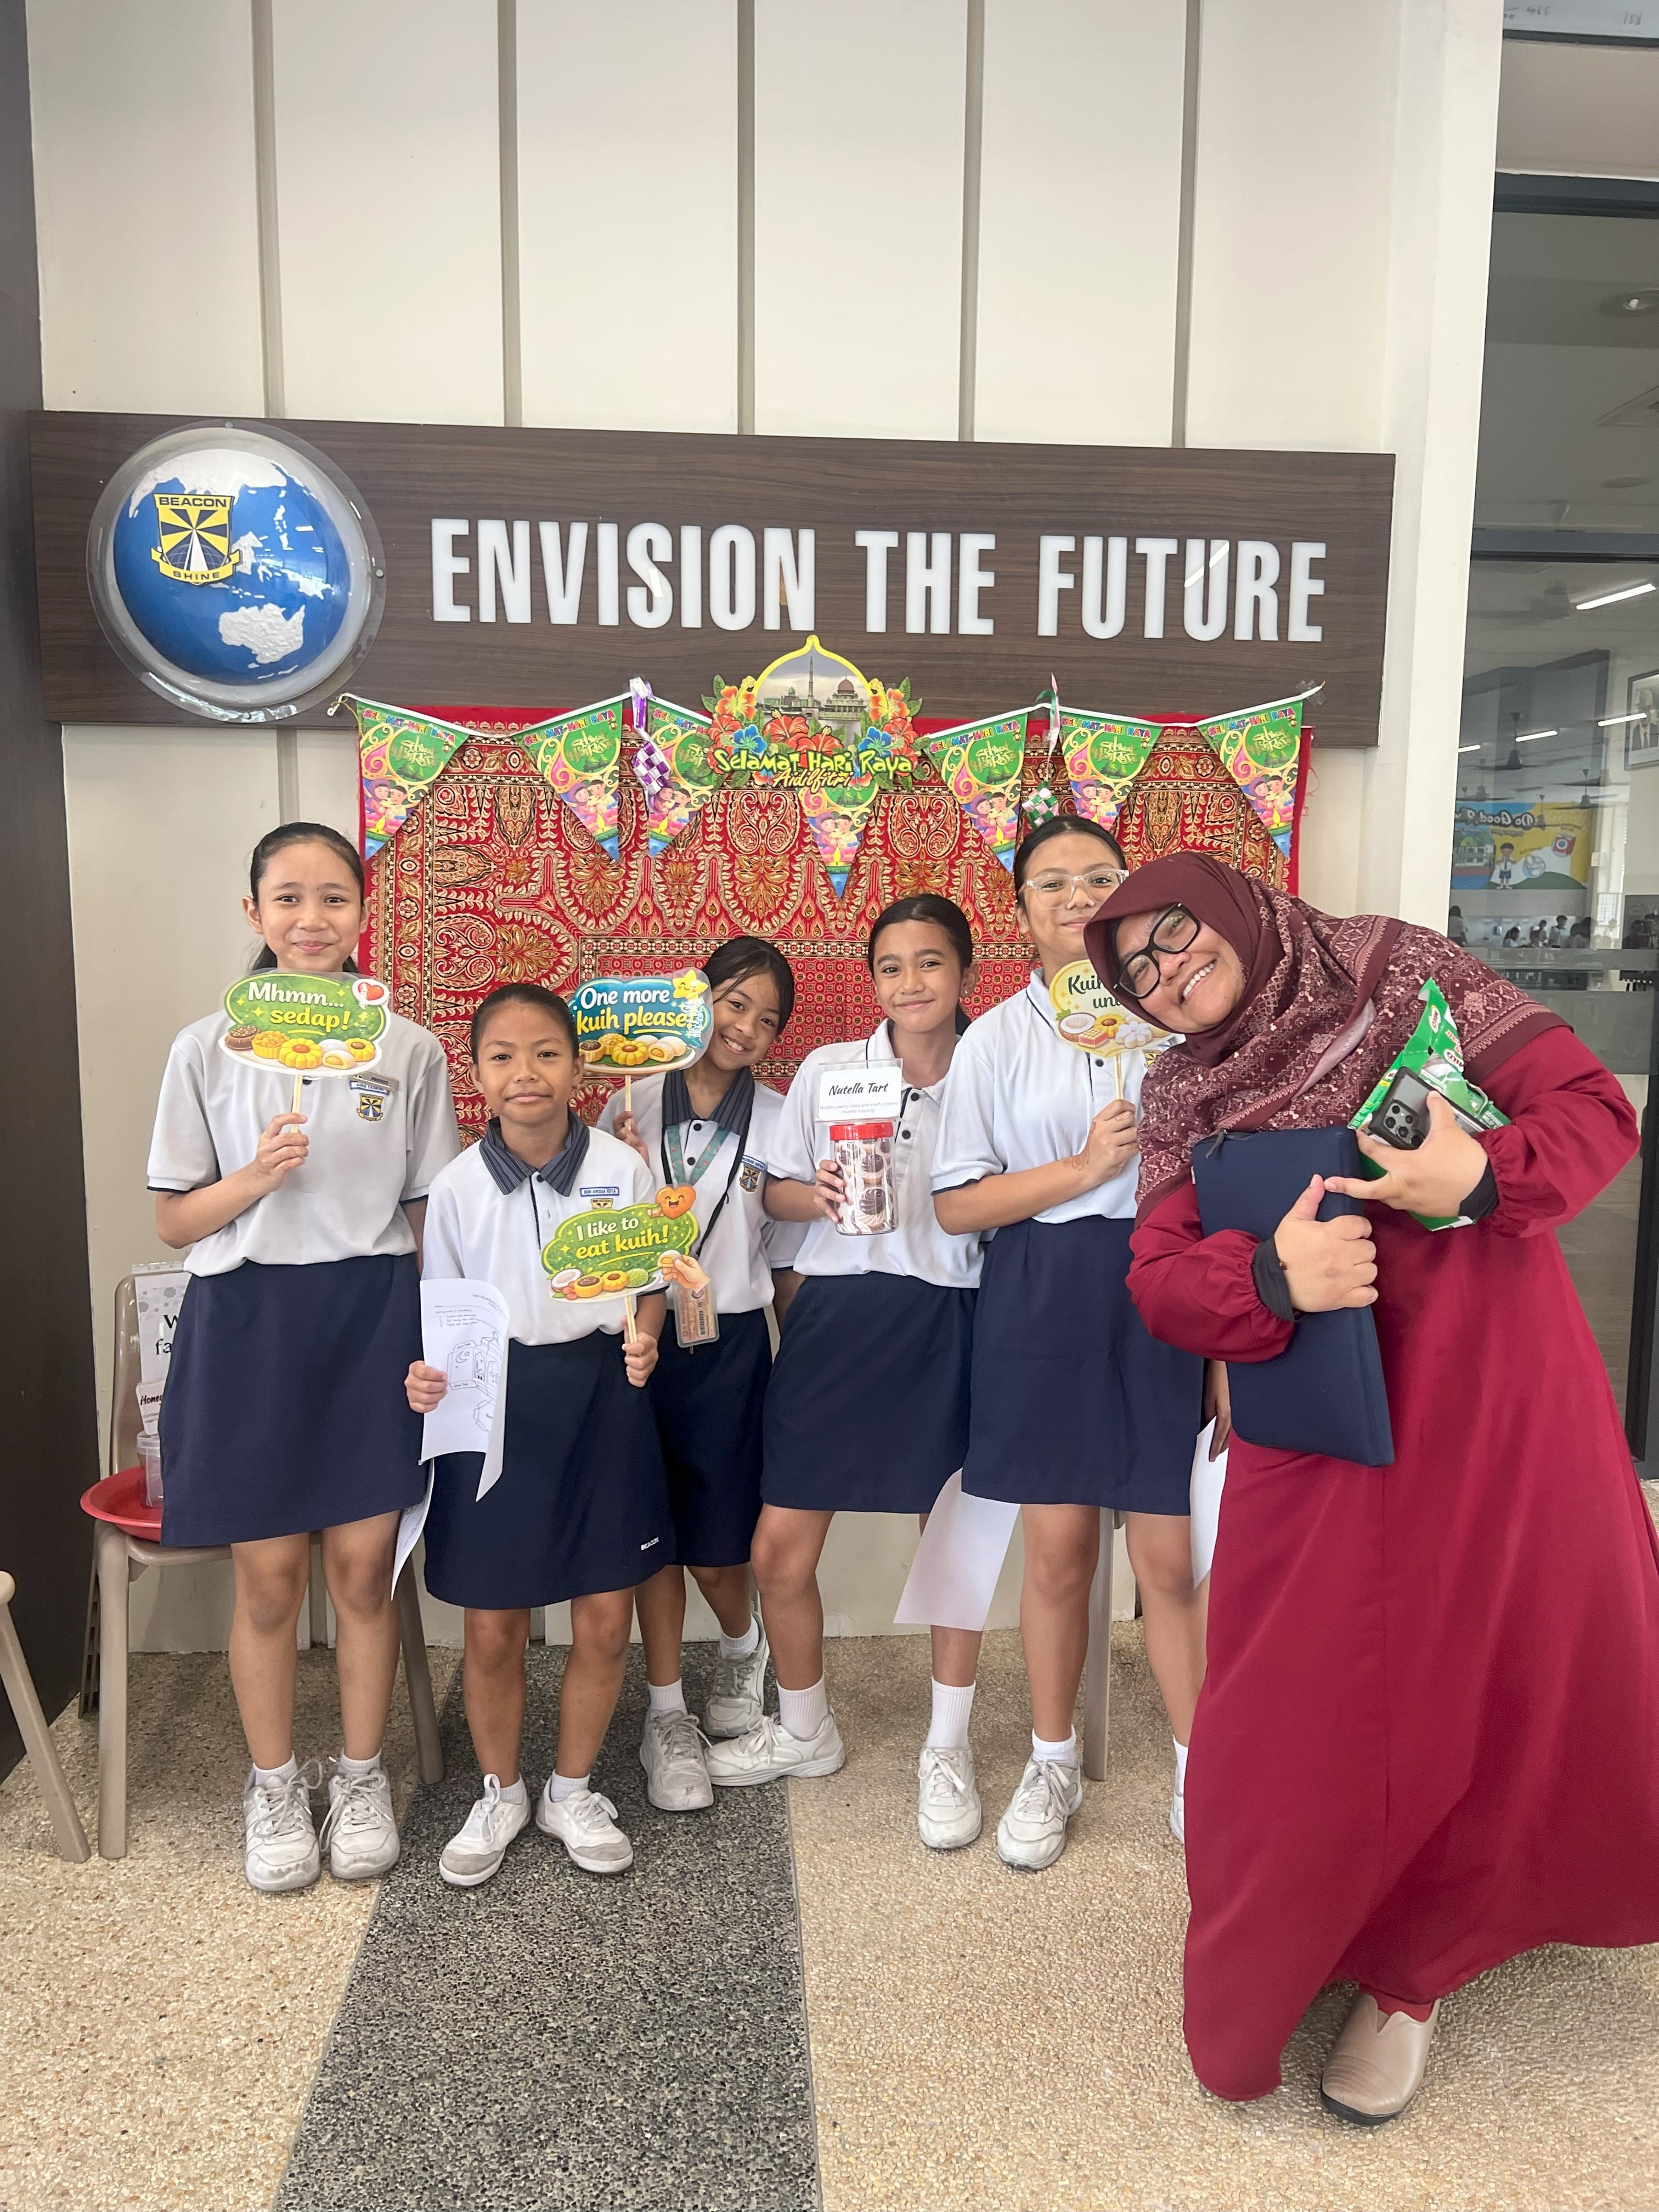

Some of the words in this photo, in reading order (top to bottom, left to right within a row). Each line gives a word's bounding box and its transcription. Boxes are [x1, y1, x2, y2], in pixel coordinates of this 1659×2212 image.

[159, 497, 227, 507] BEACON
[173, 571, 220, 580] SHINE
[431, 518, 816, 631] ENVISION
[855, 530, 996, 635] THE
[1037, 535, 1327, 642] FUTURE
[860, 749, 913, 780] Raya
[772, 768, 854, 794] Aidilfitri
[247, 981, 345, 1008] Mhmm...
[580, 988, 618, 1009] One
[623, 989, 670, 1004] more
[269, 1007, 351, 1032] sedap!
[577, 1006, 620, 1036] kuih
[623, 1005, 693, 1035] please!
[828, 1082, 864, 1096] Nutella
[867, 1082, 889, 1093] Tart
[575, 1224, 584, 1242] I
[586, 1220, 617, 1238] like
[620, 1217, 639, 1230] to
[576, 1239, 610, 1259] eat
[614, 1224, 669, 1253] kuih!
[155, 1338, 172, 1355] fa
